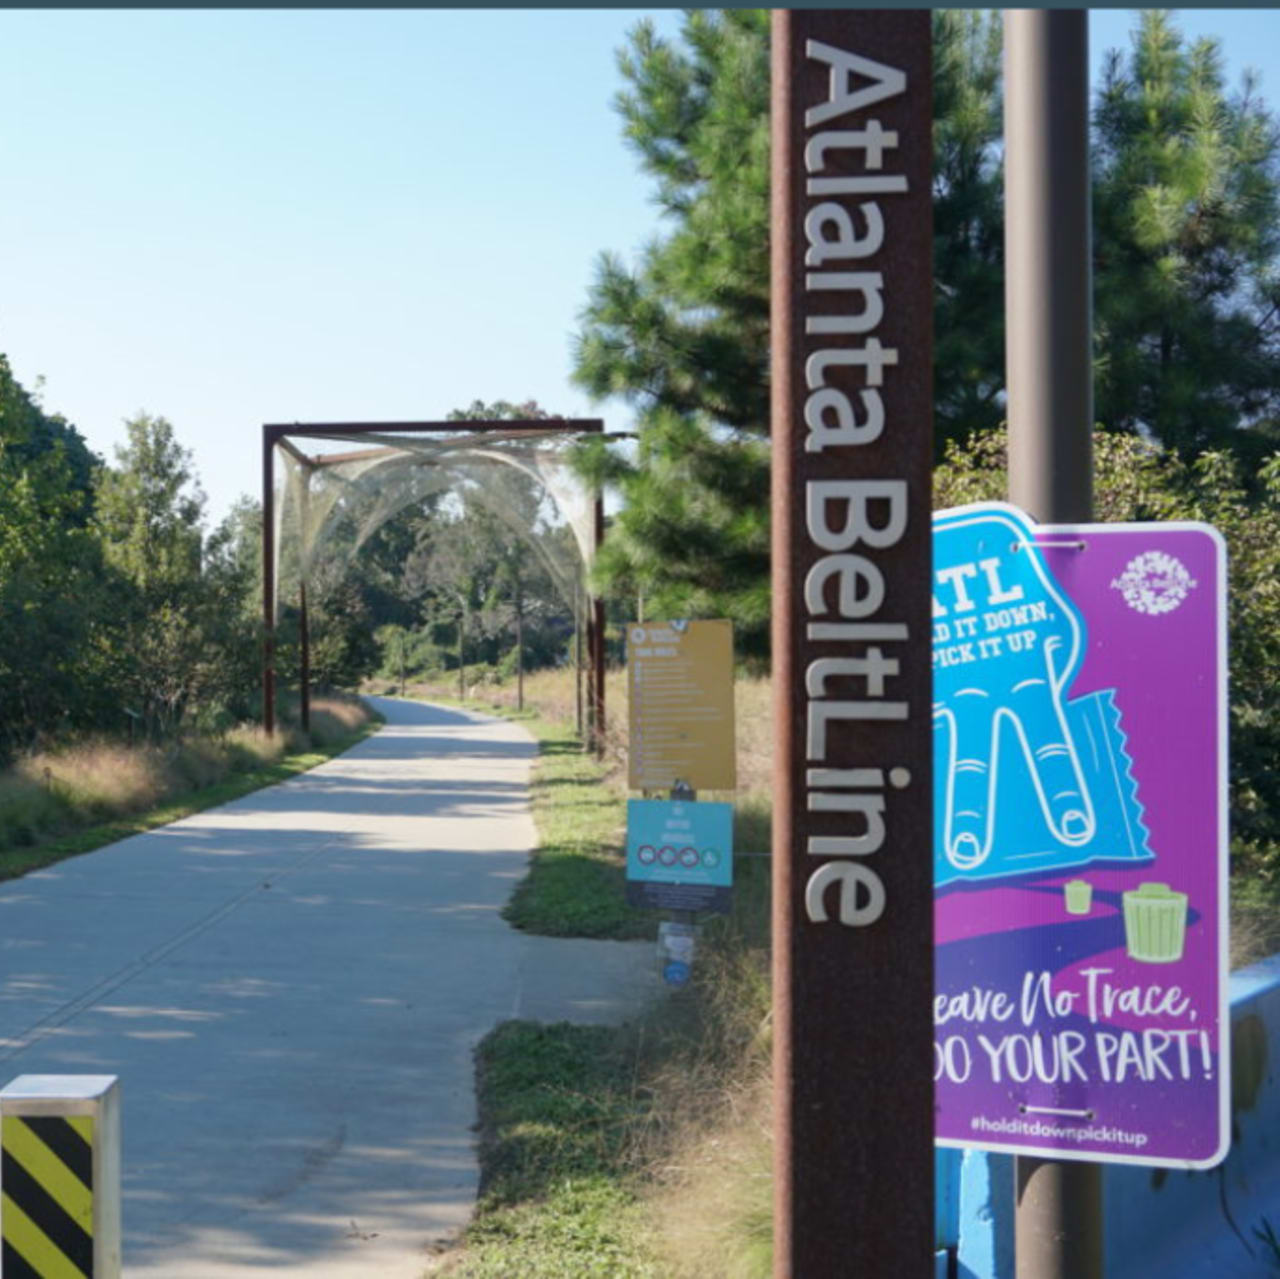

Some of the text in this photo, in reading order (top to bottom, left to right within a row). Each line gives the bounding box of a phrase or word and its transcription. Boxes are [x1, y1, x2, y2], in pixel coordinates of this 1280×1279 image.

[804, 38, 911, 928] Atlanta BeltLine
[933, 556, 1025, 618] TL
[953, 617, 978, 639] IT
[983, 601, 1055, 632] DOWN,
[978, 636, 1002, 659] IT
[1005, 629, 1037, 653] UP
[934, 967, 1197, 1026] eave No Trace,
[977, 1030, 1088, 1084] YOUR
[1095, 1027, 1214, 1083] PART!
[971, 1116, 1149, 1147] #holditdownpickitup
